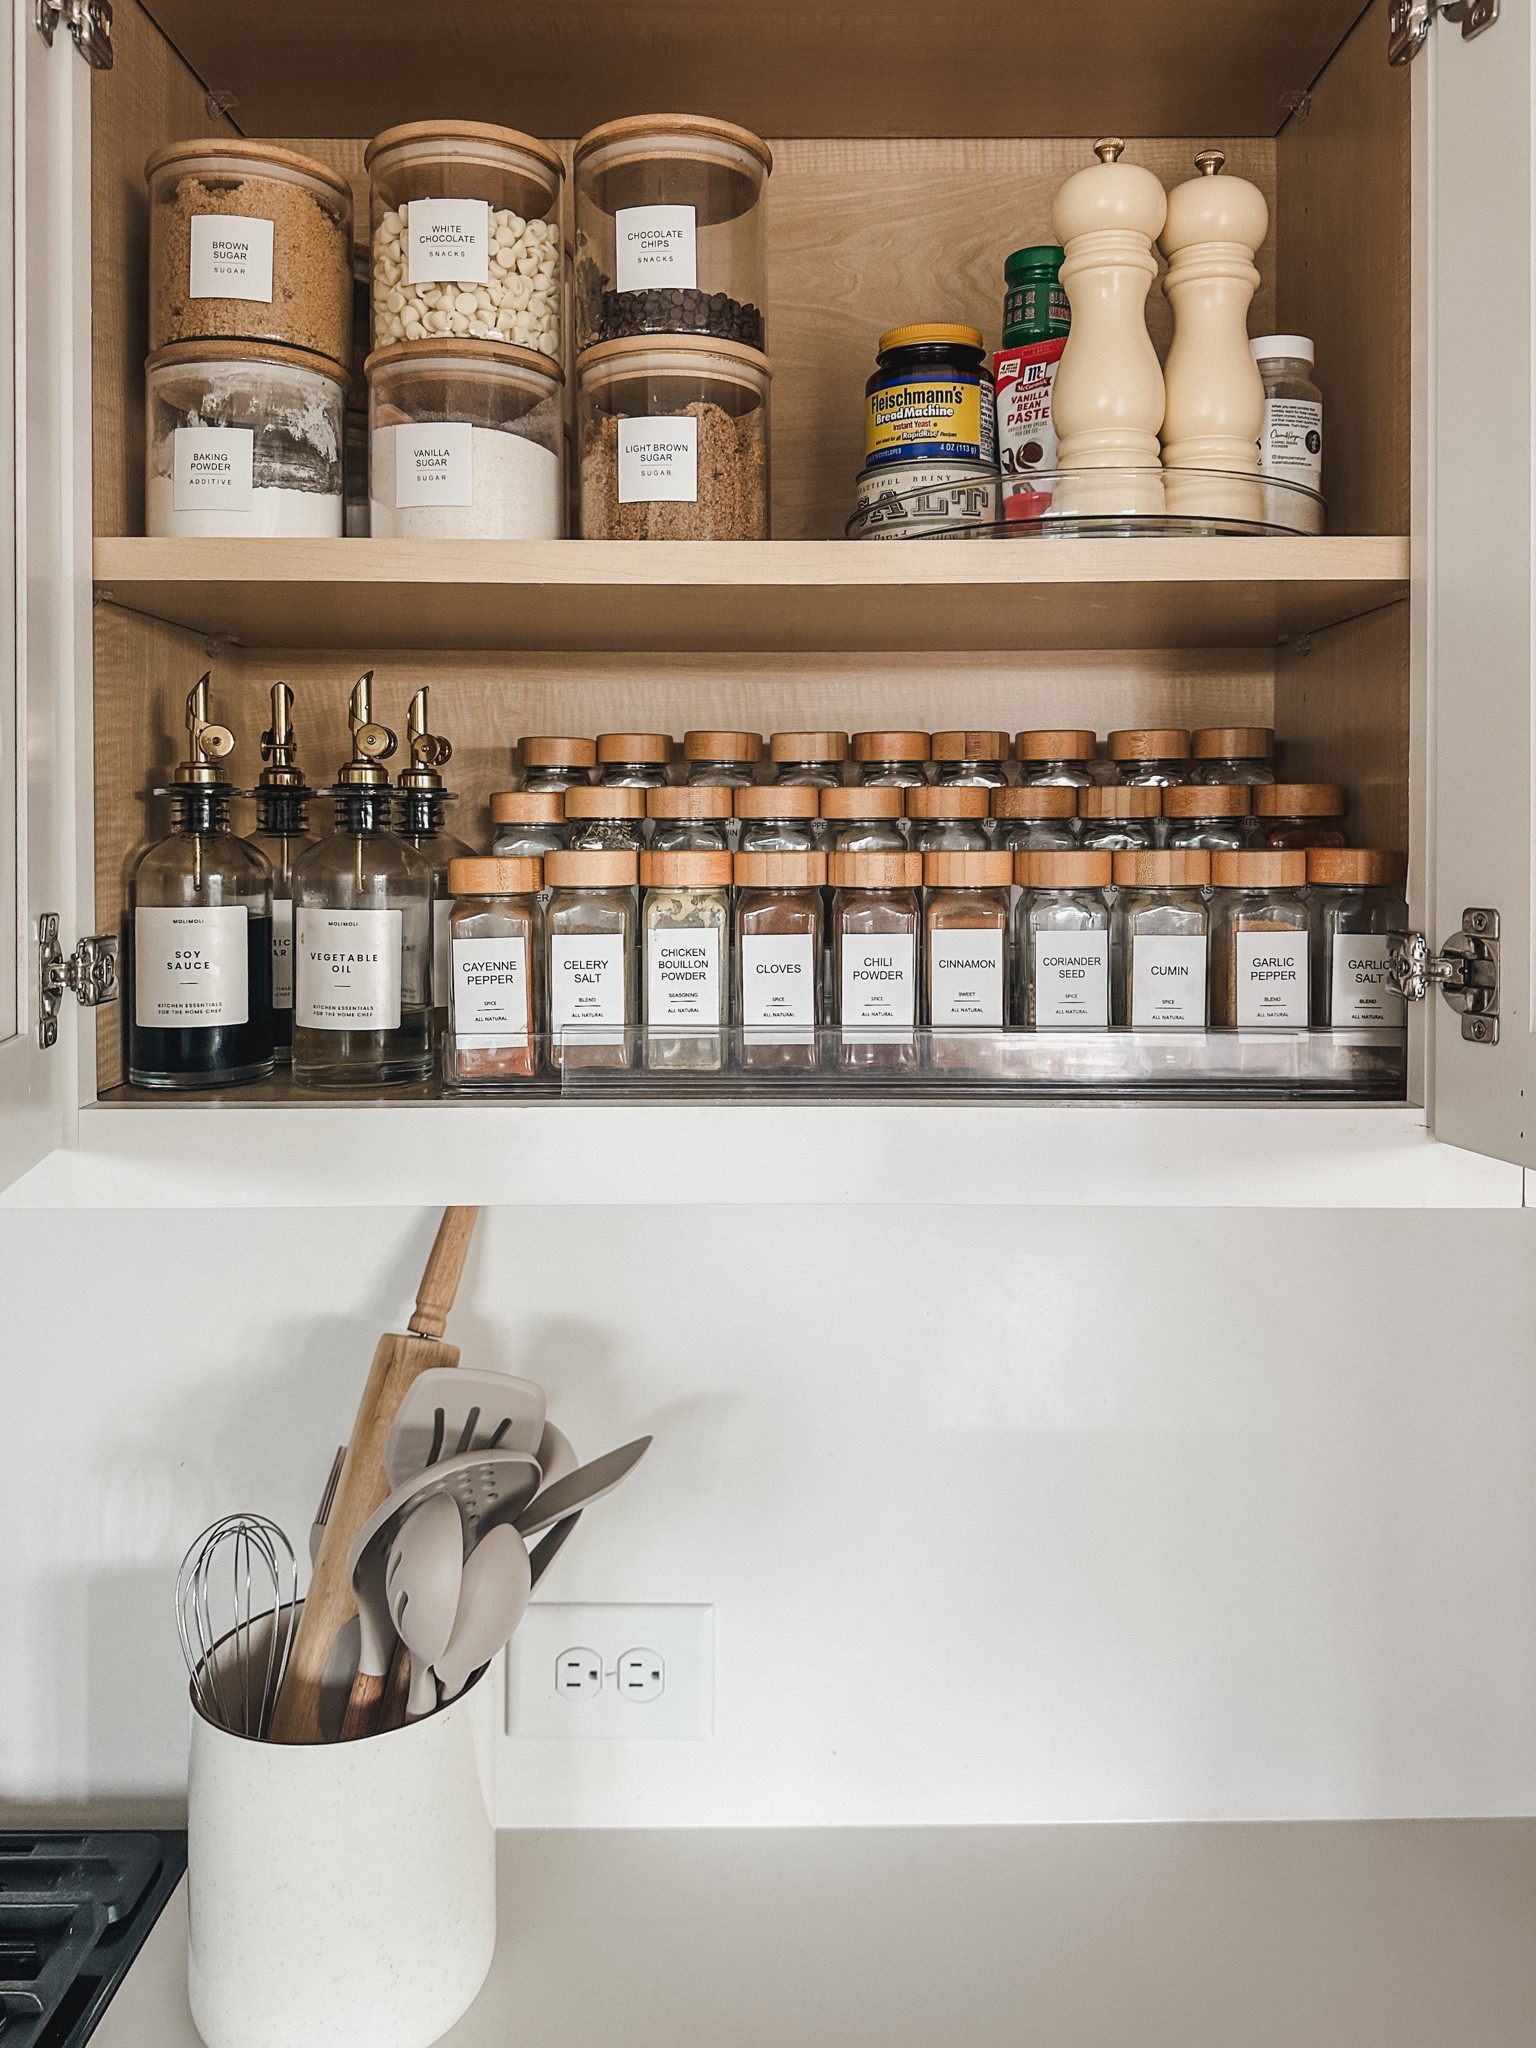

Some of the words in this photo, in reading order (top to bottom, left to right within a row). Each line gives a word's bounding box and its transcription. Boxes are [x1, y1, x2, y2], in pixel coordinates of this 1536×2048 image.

[432, 226, 462, 234] WHITE
[628, 230, 682, 240] CHOCOLATE
[420, 233, 476, 244] CHOCOLATE
[640, 239, 670, 248] CHIPS
[212, 242, 248, 251] BROWN
[214, 250, 248, 260] SUGAR
[428, 250, 466, 258] SNACKS
[638, 256, 674, 264] SNACKS
[214, 266, 246, 274] SUGAR
[871, 386, 963, 414] Fleischmann's
[1011, 390, 1049, 404] VANILLA
[1017, 400, 1041, 412] BEAN
[1007, 407, 1050, 426] PASTE
[893, 422, 913, 431] Instant
[914, 420, 931, 429] Yeast
[414, 448, 450, 459] VANILLA
[626, 444, 650, 454] LIGHT
[652, 444, 688, 454] BROWN
[956, 444, 970, 453] (113
[971, 446, 977, 454] g)
[192, 454, 228, 463] BAKING
[416, 458, 448, 468] SUGAR
[640, 454, 672, 462] SUGAR
[190, 462, 230, 470] POWDER
[190, 478, 232, 486] ADDITIVE
[416, 474, 446, 482] SUGAR
[912, 475, 952, 483] BRINY
[174, 950, 200, 958] SOY
[310, 952, 378, 962] VEGETABLE
[660, 948, 706, 958] CHICKEN
[166, 962, 210, 970] SAUCE
[462, 960, 516, 972] CAYENNE
[564, 960, 608, 970] CELERY
[658, 960, 708, 968] BOUILLON
[864, 958, 892, 967] CHILI
[938, 960, 996, 968] CINNAMON
[1042, 956, 1102, 966] CORIANDER
[1252, 958, 1294, 968] GARLIC
[1347, 958, 1391, 970] GARLIC
[332, 964, 350, 973] OIL
[756, 964, 802, 974] CLOVES
[1150, 966, 1188, 976] CUMIN
[466, 972, 514, 986] PEPPER
[574, 974, 602, 984] SALT
[662, 972, 706, 980] POWDER
[852, 970, 904, 980] POWDER
[1058, 970, 1086, 978] SEED
[1250, 970, 1296, 980] PEPPER
[1355, 973, 1384, 984] SALT
